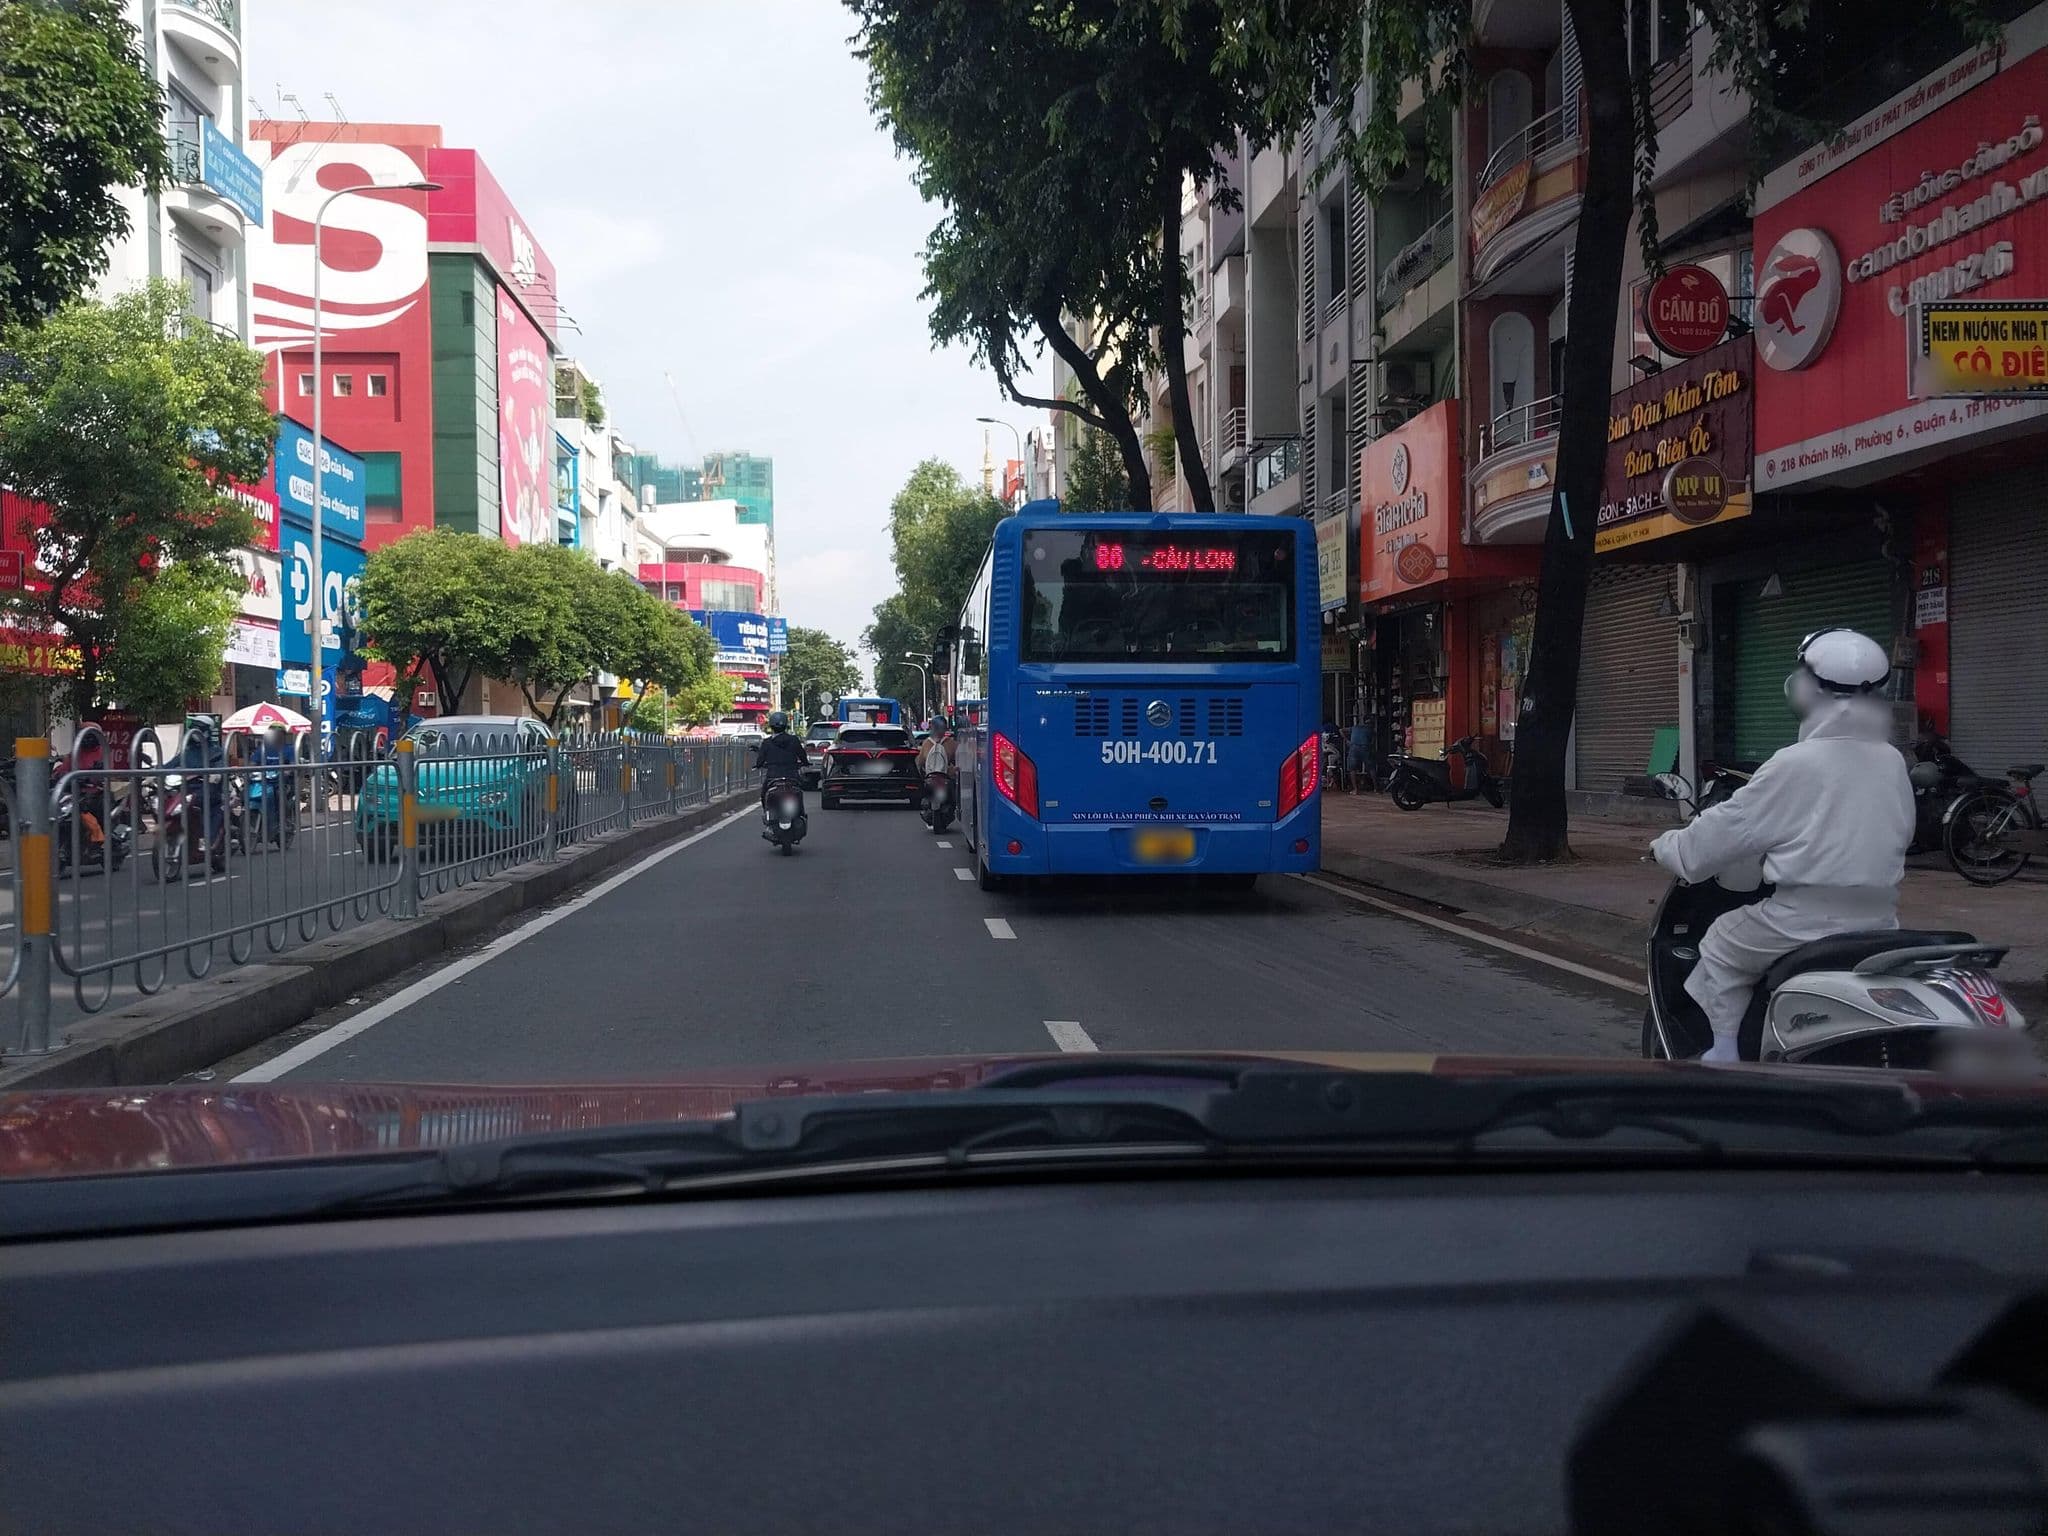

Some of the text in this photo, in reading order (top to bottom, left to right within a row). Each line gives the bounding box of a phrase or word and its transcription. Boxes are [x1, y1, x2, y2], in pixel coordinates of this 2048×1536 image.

[1660, 294, 1720, 324] CẦM ĐỒ
[1932, 320, 1960, 341] NEM
[2011, 320, 2038, 341] NHA
[1703, 369, 1741, 403] Tôm
[1781, 460, 1796, 474] 218
[1798, 449, 1829, 469] Khánh
[1854, 425, 1893, 451] Phường
[1913, 410, 1946, 435] Quận
[1625, 449, 1655, 479] Bún
[1656, 437, 1688, 468] Riêu
[1625, 494, 1651, 515] SẠCH
[1922, 567, 1941, 586] 218
[1101, 741, 1218, 764] 50H-400.71
[1175, 812, 1187, 820] XE
[1188, 812, 1199, 820] RA
